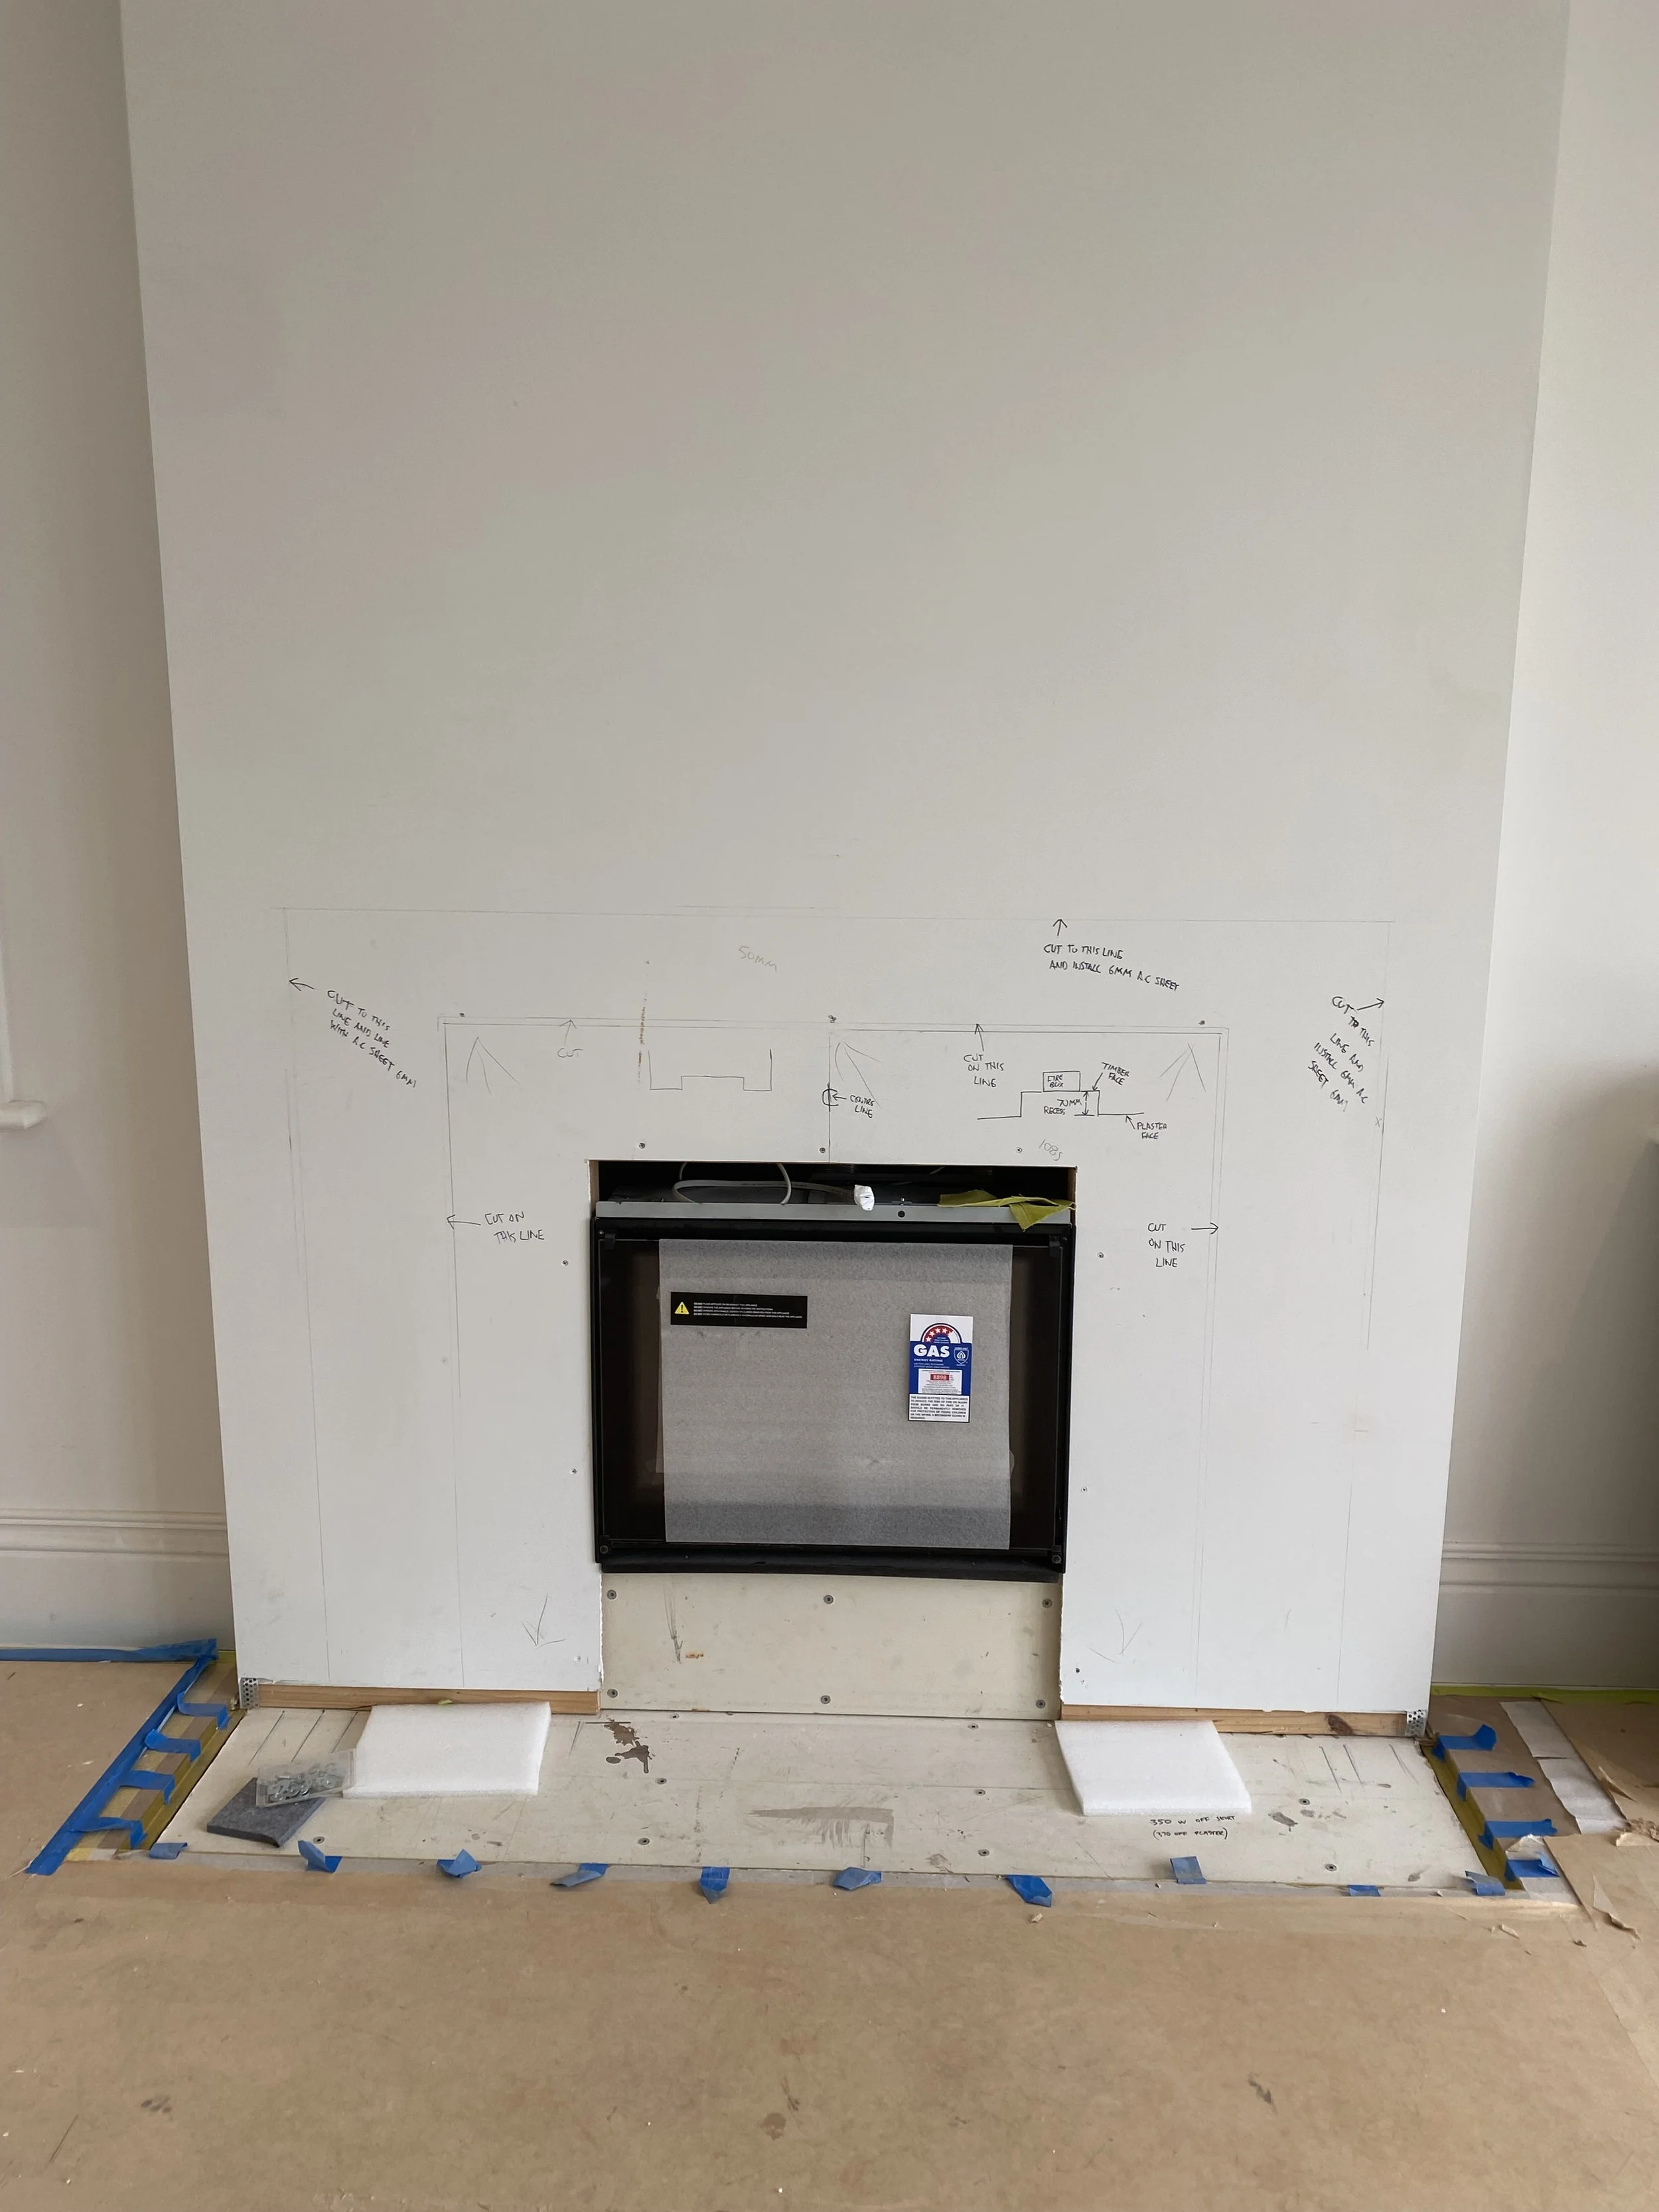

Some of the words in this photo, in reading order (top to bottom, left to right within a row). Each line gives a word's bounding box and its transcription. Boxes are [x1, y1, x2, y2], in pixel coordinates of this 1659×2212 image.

[1043, 944, 1062, 954] CUT
[1068, 944, 1078, 953] TO
[1081, 946, 1100, 955] THIS
[1102, 947, 1123, 960] LINE
[1049, 960, 1068, 970] AND
[1072, 961, 1102, 974] INSTALL
[1108, 965, 1132, 978] 6MM
[1155, 977, 1180, 992] SHEET
[327, 990, 354, 1010] CUT
[358, 1007, 367, 1017] TO
[372, 1015, 391, 1031] THIS
[332, 1008, 352, 1026] LINE
[354, 1022, 371, 1037] AND
[374, 1033, 390, 1048] LINE
[1332, 996, 1356, 1014] CUT
[1360, 1027, 1375, 1047] THIS
[330, 1020, 348, 1037] WITH
[369, 1047, 395, 1071] SHEET
[396, 1070, 417, 1088] 6MM
[557, 1048, 583, 1058] CUT
[964, 1053, 983, 1063] CUT
[985, 1062, 1004, 1071] THIS
[1102, 1062, 1130, 1076] TIMBER
[974, 1076, 997, 1088] LINE
[1108, 1072, 1125, 1086] FACE
[855, 1105, 873, 1118] LINE
[1044, 1106, 1066, 1115] RECESS
[1137, 1122, 1167, 1130] PLASTER
[484, 1213, 504, 1225] CUT
[509, 1211, 524, 1222] ON
[1147, 1222, 1167, 1232] CUT
[494, 1230, 516, 1244] THIS
[520, 1229, 544, 1240] LINE
[1149, 1238, 1161, 1249] ON
[1166, 1240, 1186, 1253] THIS
[1156, 1257, 1178, 1268] LINE
[914, 1344, 950, 1358] GAS
